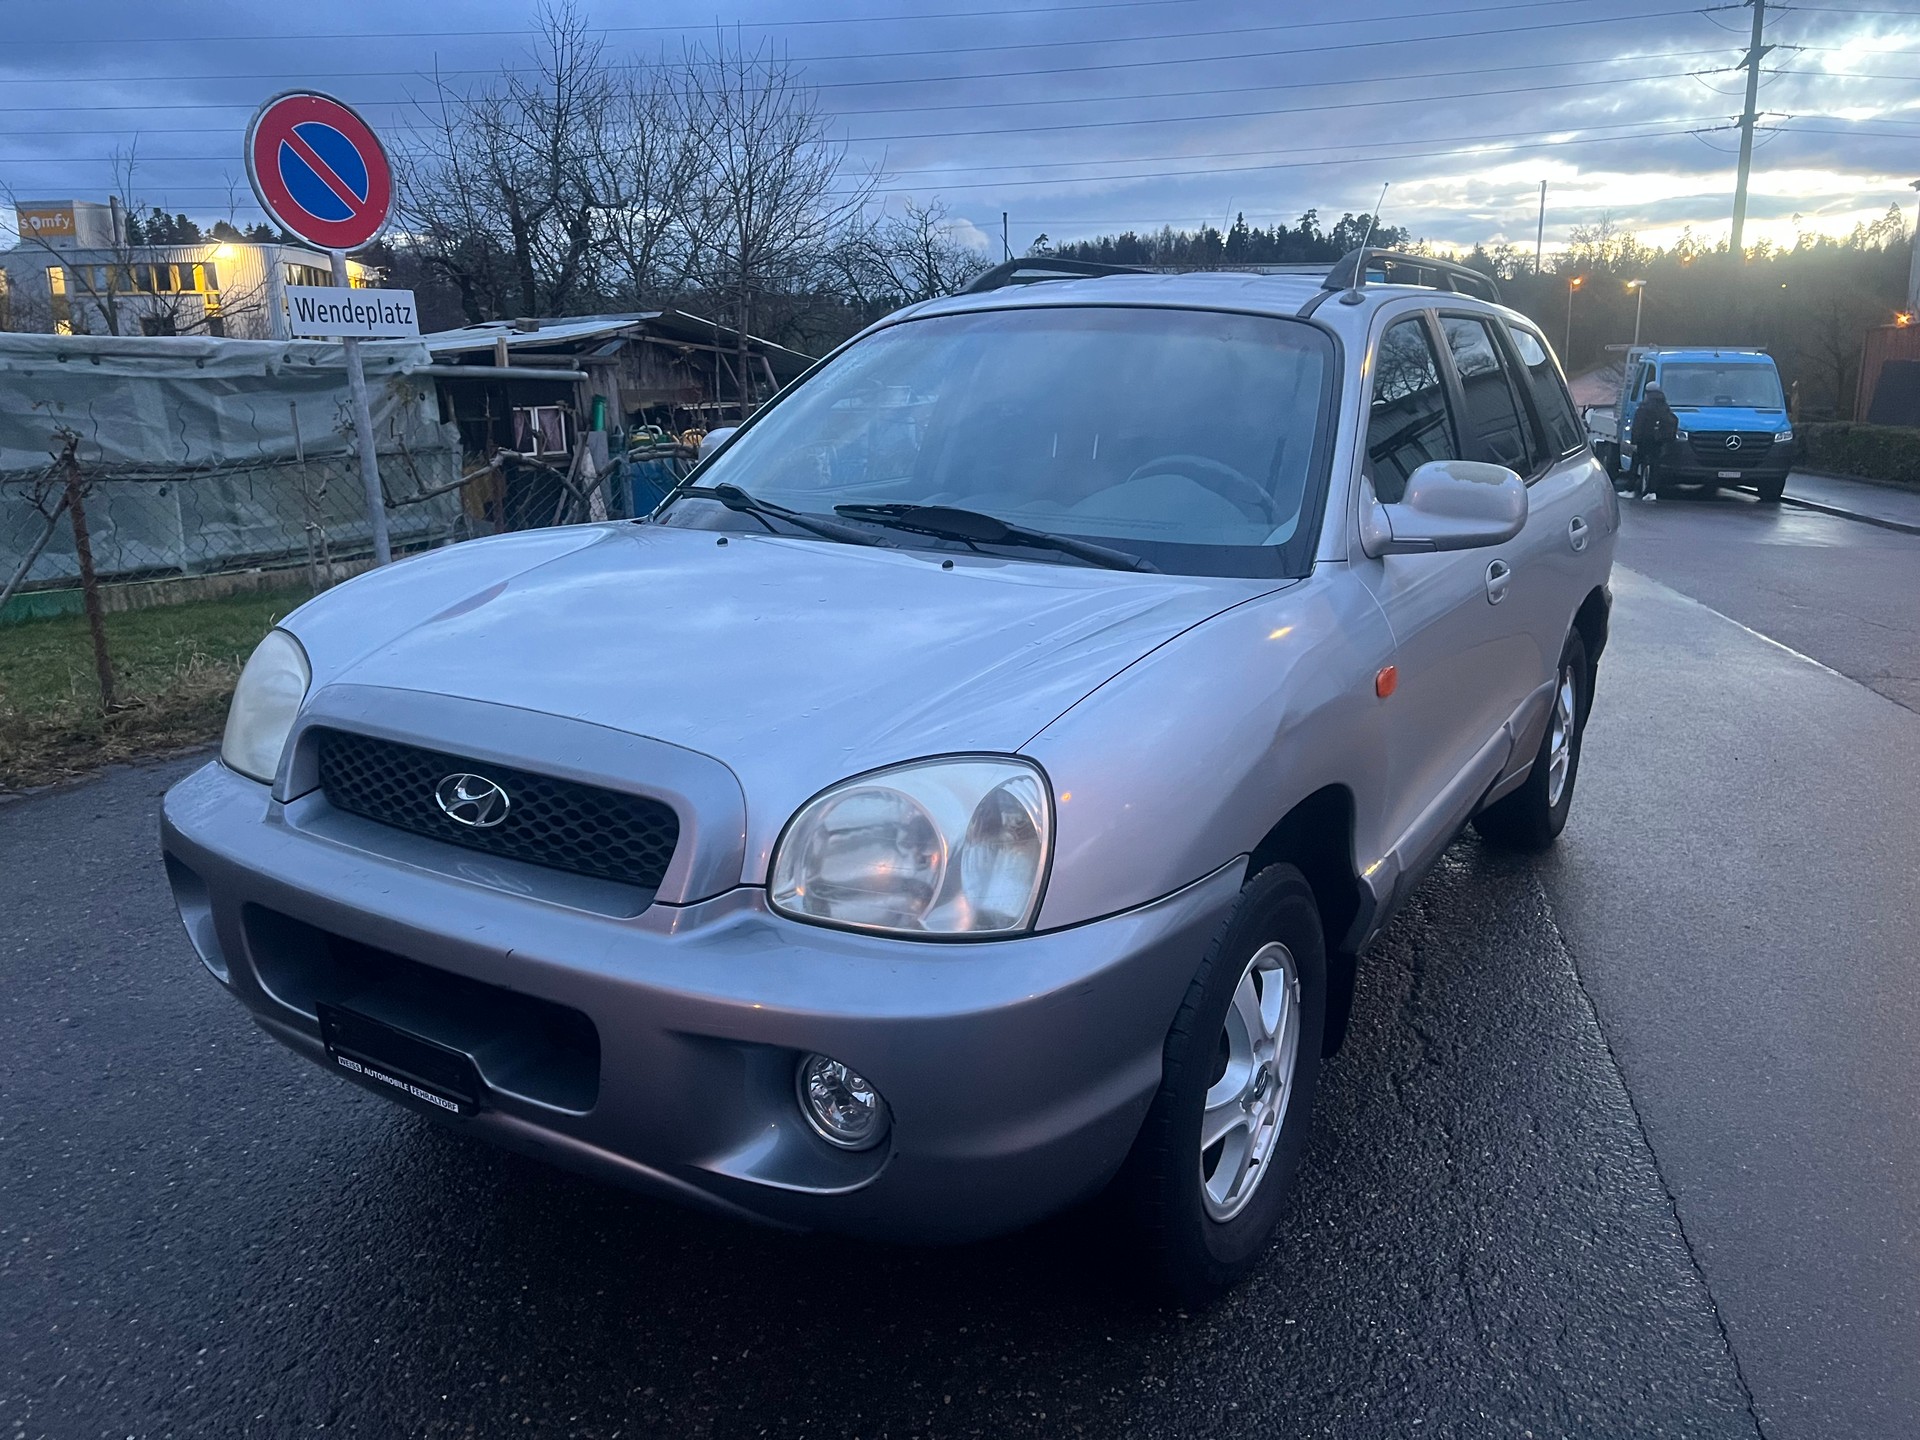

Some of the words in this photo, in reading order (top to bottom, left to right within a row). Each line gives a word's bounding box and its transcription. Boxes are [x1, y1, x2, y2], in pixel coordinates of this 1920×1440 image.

[20, 213, 70, 230] somfy
[294, 297, 413, 330] Wendeplatz
[364, 1067, 409, 1092] AUTOMOBILE
[411, 1086, 458, 1112] FEHRALTORF
